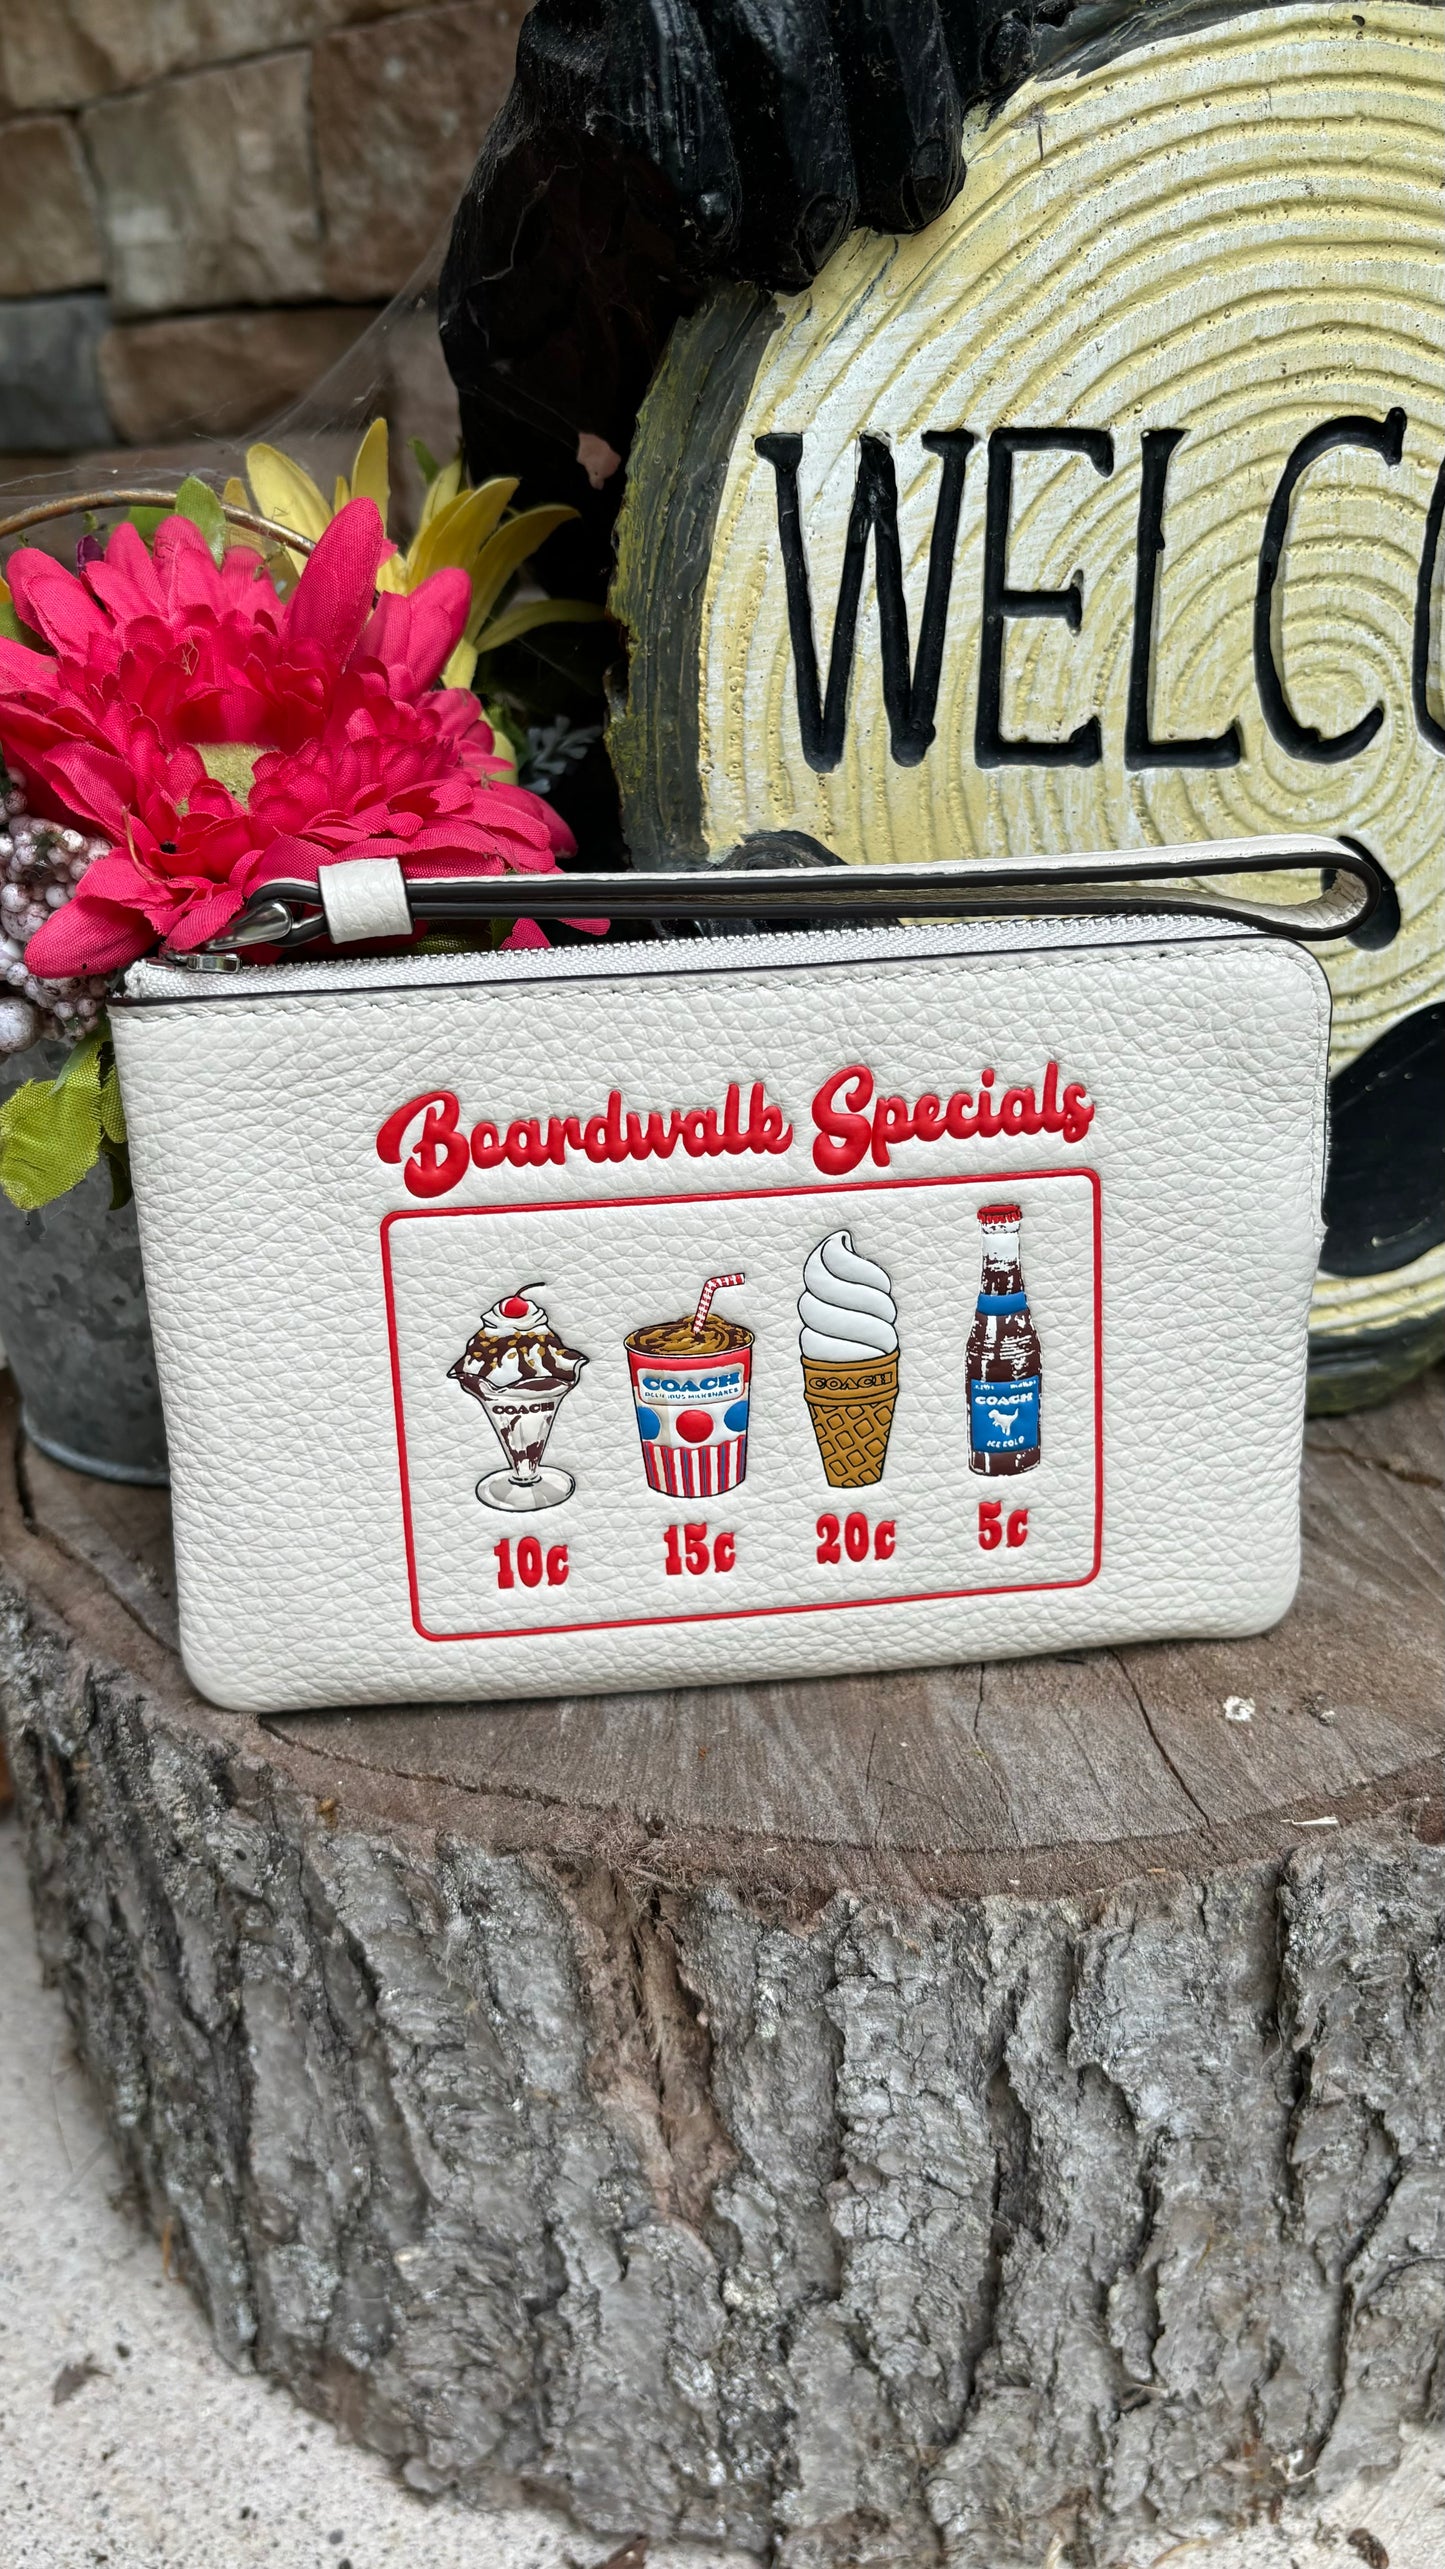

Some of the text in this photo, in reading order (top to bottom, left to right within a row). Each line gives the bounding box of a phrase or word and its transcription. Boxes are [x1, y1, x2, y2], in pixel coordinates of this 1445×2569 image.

[754, 406, 1445, 773] WELC
[376, 1062, 1095, 1198] Boardwalk Specials
[642, 1371, 740, 1392] COACH
[808, 1372, 893, 1390] COACH
[491, 1402, 555, 1415] COACH
[974, 1392, 1033, 1406] COACH
